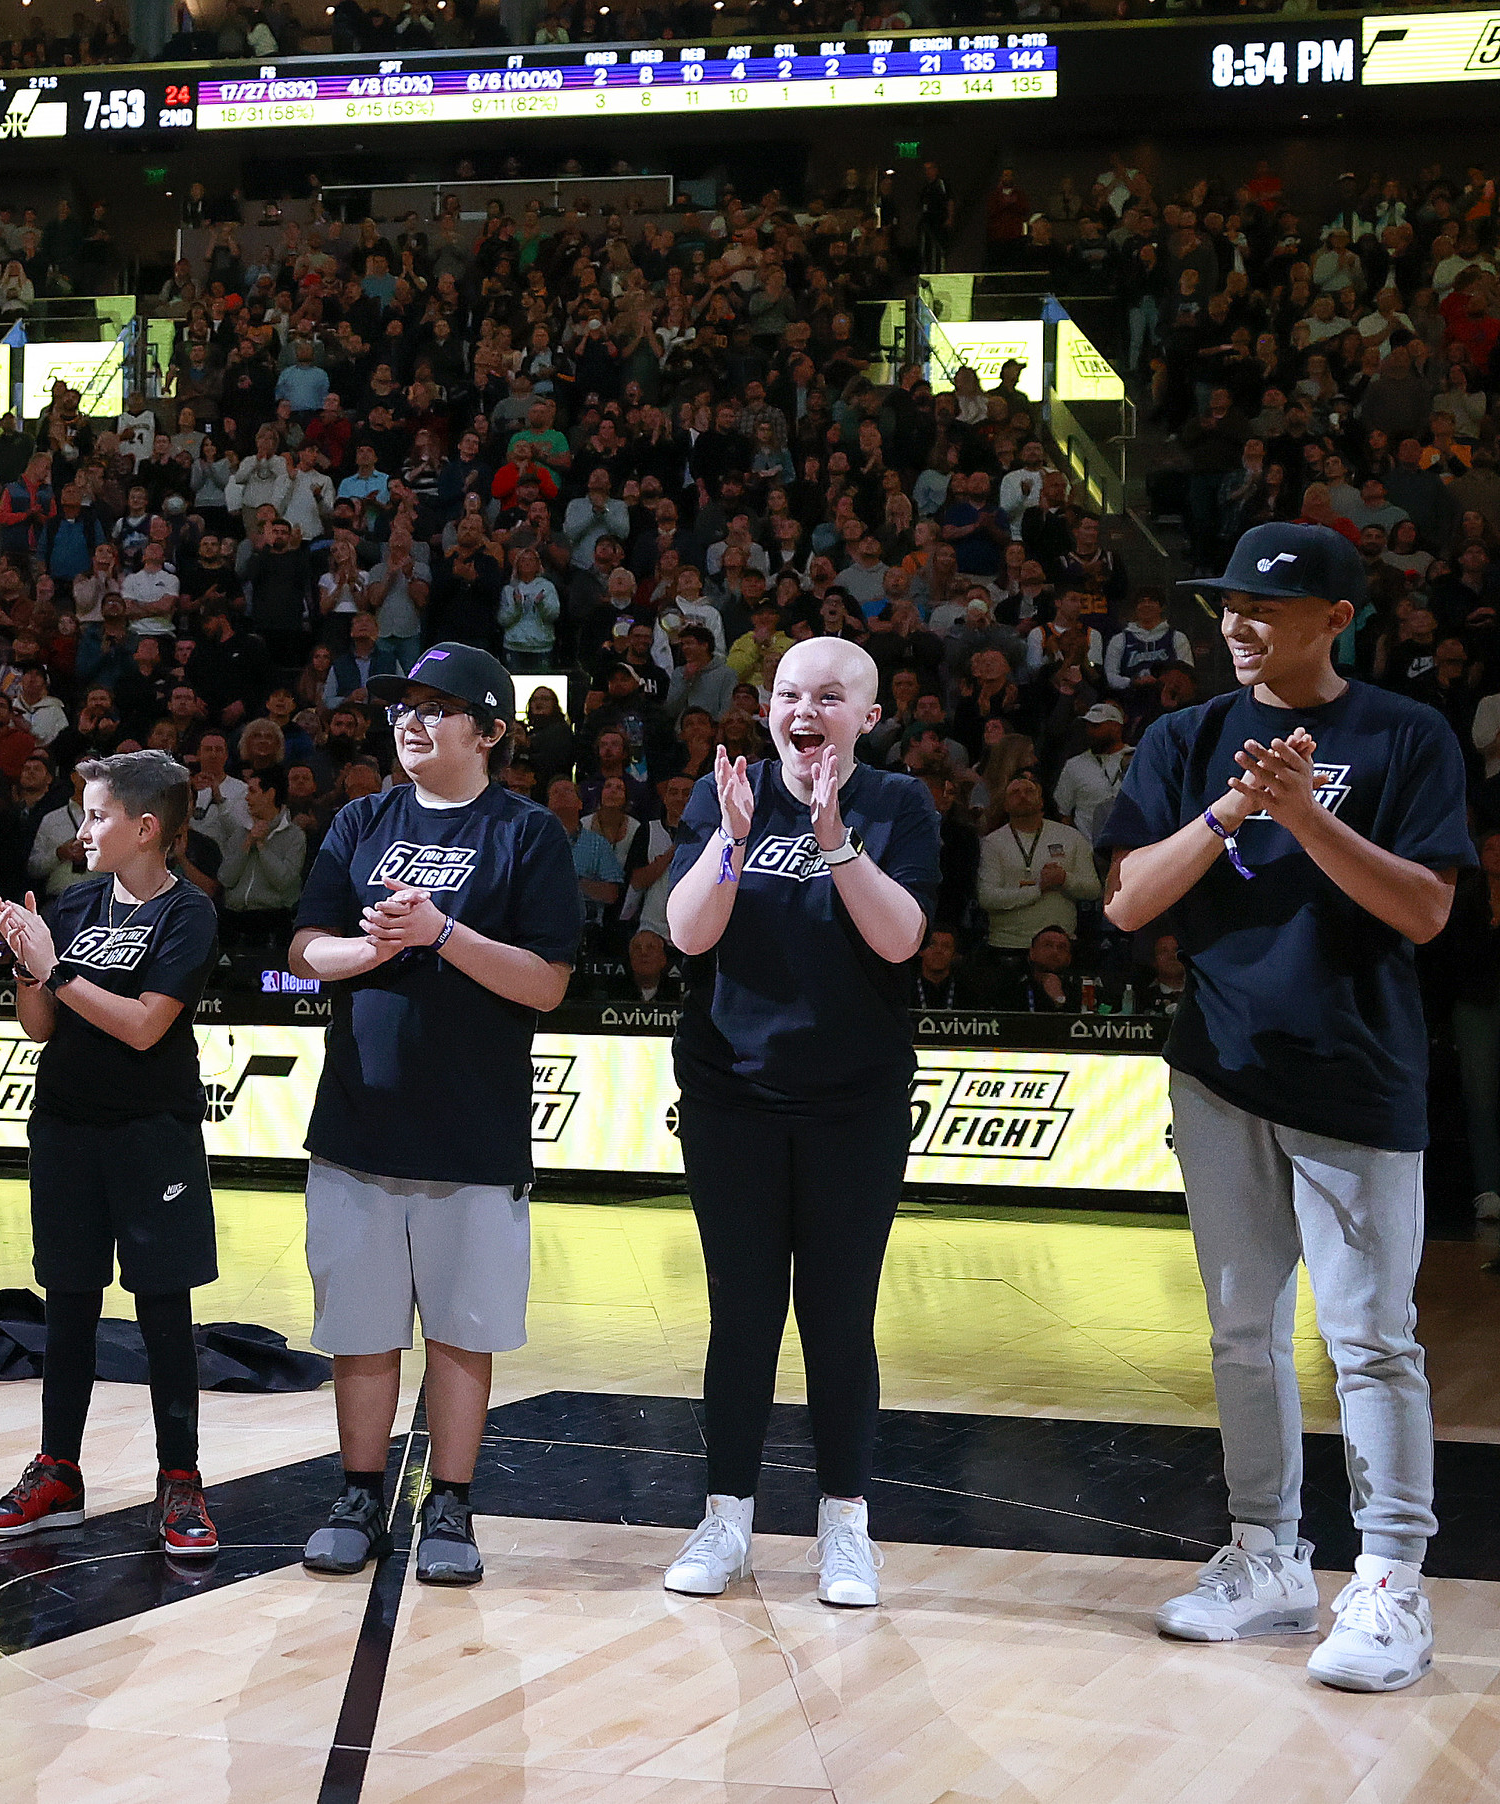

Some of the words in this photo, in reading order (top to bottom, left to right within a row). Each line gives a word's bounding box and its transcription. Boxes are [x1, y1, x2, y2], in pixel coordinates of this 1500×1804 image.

[260, 67, 277, 79] FG
[507, 56, 523, 69] FT
[680, 48, 705, 62] REB
[727, 46, 752, 60] AST
[774, 43, 798, 58] STL
[820, 41, 846, 55] BLK
[910, 37, 952, 52] BENCH
[1212, 42, 1287, 87] 8:54
[1297, 38, 1354, 84] PM
[29, 78, 38, 89] 2
[39, 77, 58, 88] FLS
[220, 83, 267, 101] 17/27
[268, 81, 318, 99] (63%)
[347, 78, 380, 96] 4/8
[383, 75, 433, 95] (50%)
[467, 73, 501, 91] 6/6
[503, 70, 564, 90] (100%)
[593, 69, 607, 86] 2
[639, 67, 654, 84] 8
[682, 64, 704, 82] 10
[731, 62, 746, 80] 4
[778, 61, 792, 79] 2
[825, 59, 839, 76] 2
[873, 57, 887, 75] 5
[920, 55, 941, 73] 21
[961, 53, 995, 71] 135
[1009, 51, 1045, 70] 144
[165, 85, 191, 105] 24
[221, 107, 267, 123] 18/31
[268, 104, 316, 121] (58%)
[346, 101, 385, 118] 8/15
[388, 99, 434, 116] (53%)
[472, 96, 508, 112] 9/11
[511, 94, 558, 112] (82%)
[596, 93, 606, 108] 3
[641, 91, 651, 106] 8
[686, 90, 700, 105] 11
[729, 88, 748, 103] 10
[782, 87, 789, 101] 1
[829, 84, 836, 99] 1
[874, 83, 885, 97] 4
[920, 80, 942, 96] 23
[962, 79, 993, 95] 144
[1011, 76, 1043, 93] 135
[83, 89, 146, 129] 7:53
[159, 107, 192, 127] 2ND
[758, 842, 794, 867] 5
[803, 839, 818, 851] FO
[380, 847, 413, 877] 5
[421, 850, 443, 862] FOR
[443, 852, 466, 863] THE
[403, 867, 465, 887] FIGHT
[71, 932, 107, 956] 5
[90, 947, 140, 965] FIGHT
[938, 1017, 1000, 1036] vivint
[1094, 1020, 1154, 1040] vivint
[19, 1050, 43, 1066] FO
[534, 1066, 558, 1083] HE
[965, 1080, 1005, 1098] FOR
[1010, 1081, 1050, 1099] THE
[941, 1116, 1054, 1148] FIGHT
